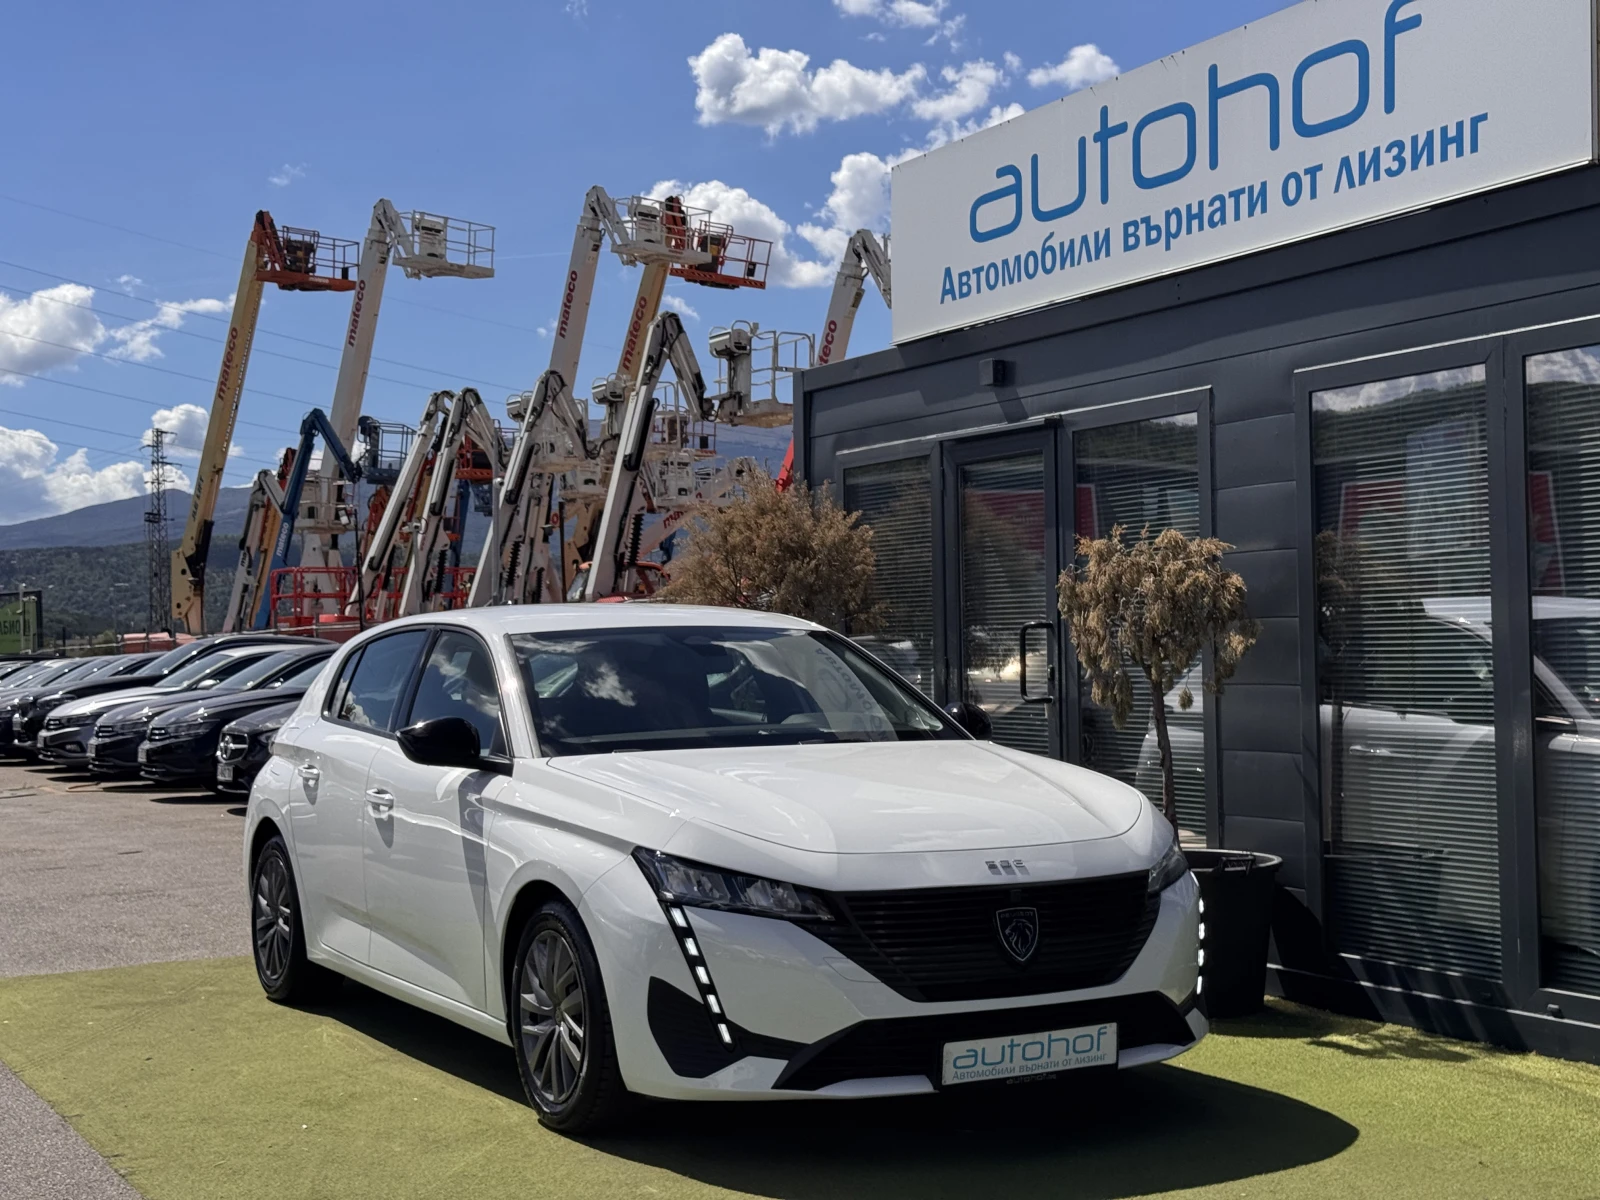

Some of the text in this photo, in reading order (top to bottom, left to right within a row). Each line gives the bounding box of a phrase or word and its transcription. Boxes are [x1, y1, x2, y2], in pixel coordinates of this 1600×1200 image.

[969, 0, 1423, 243] autohof
[940, 113, 1489, 303] Автомобили върнати от лизинг
[348, 279, 366, 348] mateco
[559, 270, 578, 339] mateco
[622, 296, 647, 371] mateco
[217, 326, 239, 402] mateco
[818, 319, 838, 366] teco
[275, 521, 290, 557] mateco
[952, 1025, 1108, 1070] autohof
[952, 1052, 1107, 1081] Автомобили върнати от лизинг
